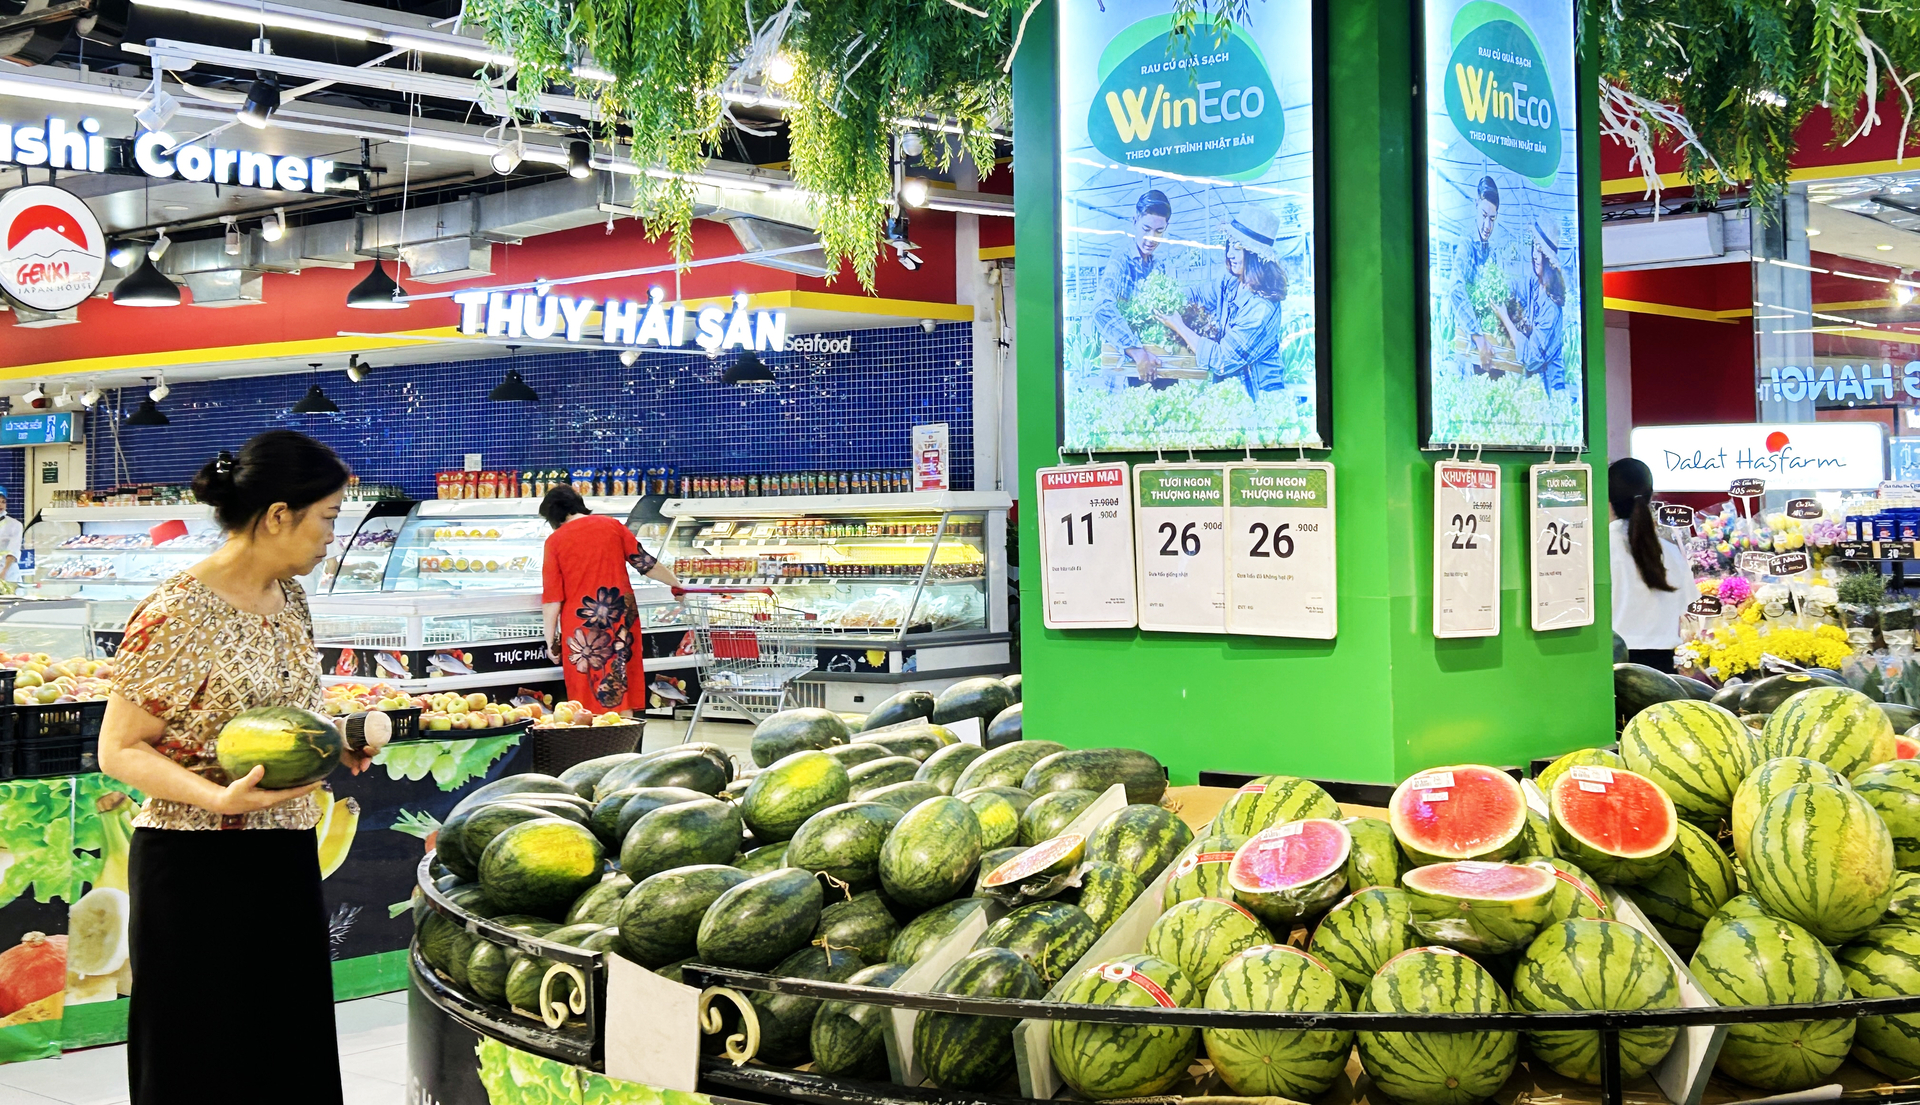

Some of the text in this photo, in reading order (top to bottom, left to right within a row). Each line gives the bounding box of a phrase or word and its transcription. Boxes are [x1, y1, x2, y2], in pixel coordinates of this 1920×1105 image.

[1141, 63, 1161, 75] RAU
[1201, 53, 1229, 67] SẠCH
[1455, 63, 1552, 129] WinEco
[1105, 81, 1264, 144] WinEco
[1125, 133, 1255, 161] THEO QUY TRÌNH NHẬT BẢN
[1469, 131, 1486, 142] THEO
[1487, 134, 1500, 145] QUY
[134, 129, 334, 194] Corner
[16, 261, 70, 285] GENKI
[18, 283, 92, 295] JAPAN HOUSE
[784, 333, 852, 354] Seafood
[1663, 447, 1847, 475] Dalat Hasfarm
[1097, 470, 1119, 485] MẠI
[1158, 477, 1211, 487] TƯƠI NGON
[1249, 476, 1307, 487] TƯƠI NGON
[1150, 489, 1220, 502] THƯỢNG HẠNG
[1240, 488, 1316, 502] THƯỢNG HẠNG
[1060, 512, 1094, 546] 11
[1158, 521, 1223, 557] 26 .900đ
[1249, 522, 1319, 559] 26 .900đ
[1451, 513, 1478, 550] 22
[1546, 521, 1571, 556] 26
[494, 649, 523, 664] THỰC
